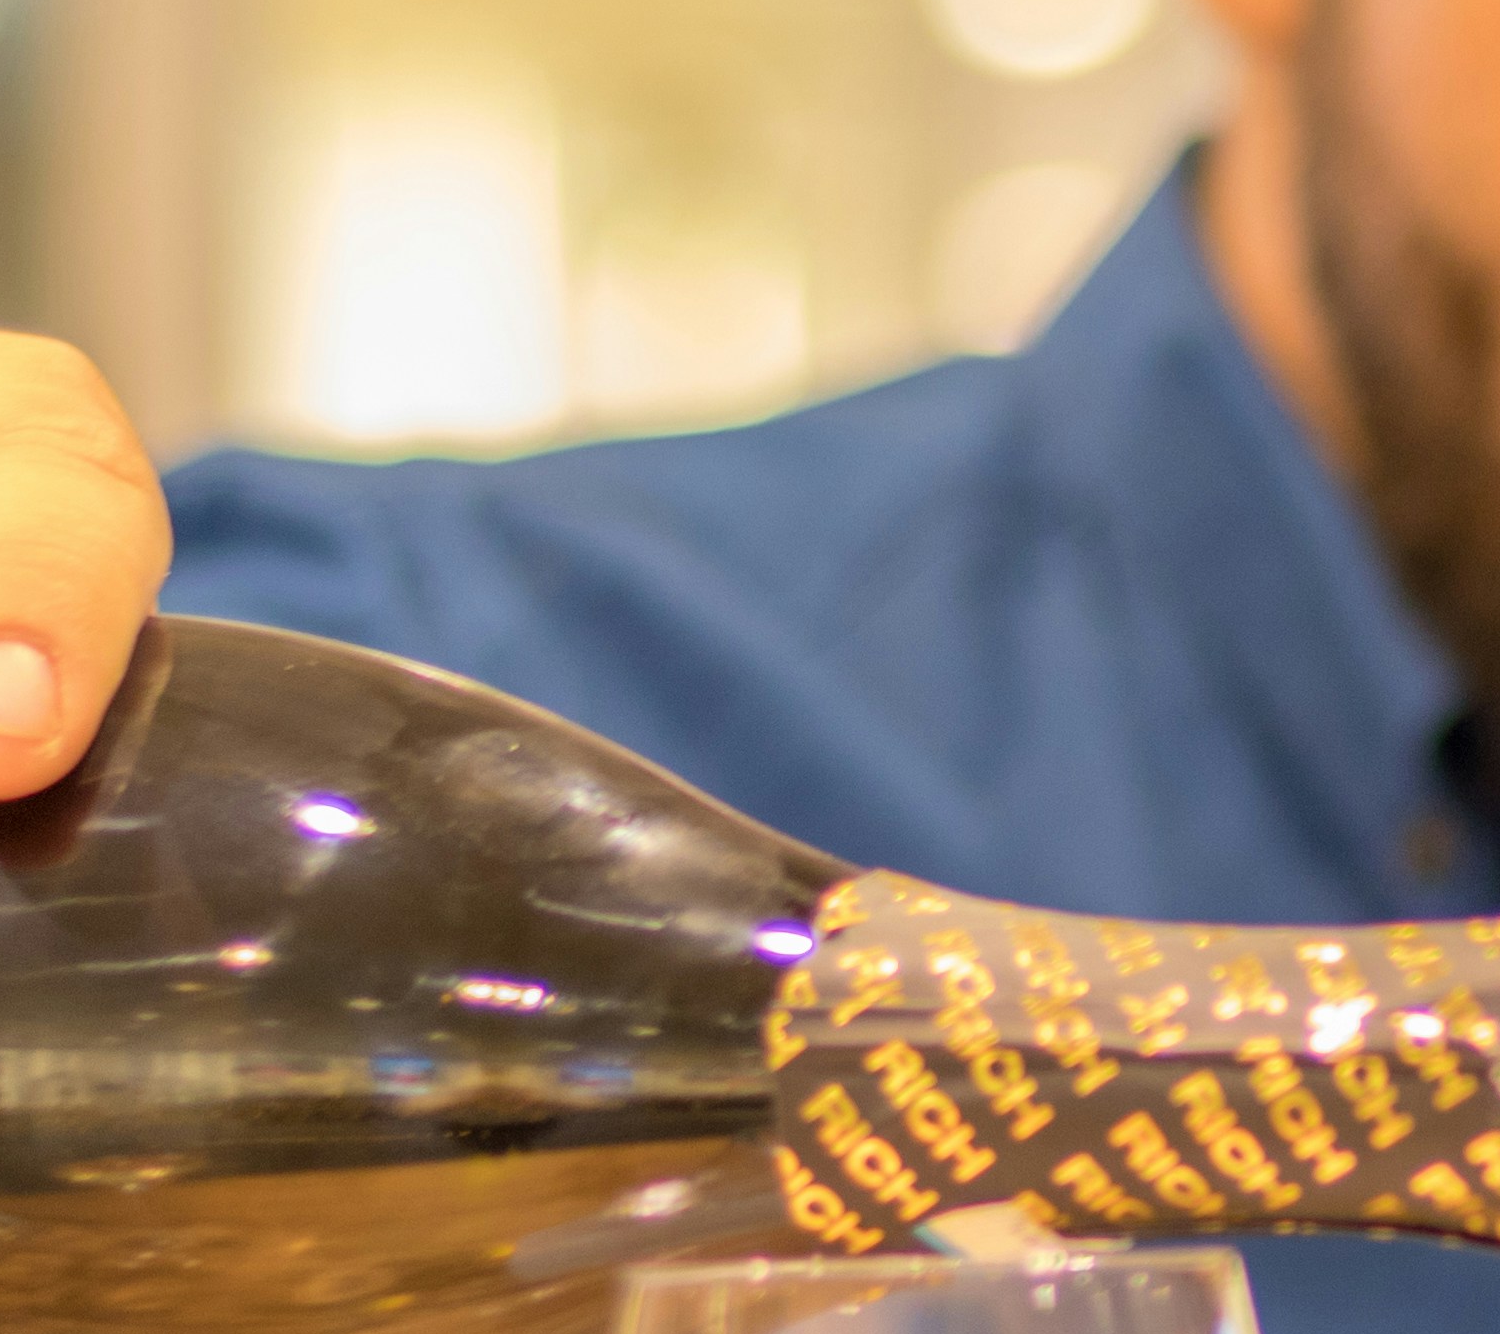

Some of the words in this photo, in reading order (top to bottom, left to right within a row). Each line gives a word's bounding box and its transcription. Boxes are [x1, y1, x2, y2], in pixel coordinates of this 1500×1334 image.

[801, 1082, 941, 1223] RICH
[863, 1038, 997, 1185] RICH
[1168, 1069, 1303, 1212] RICH
